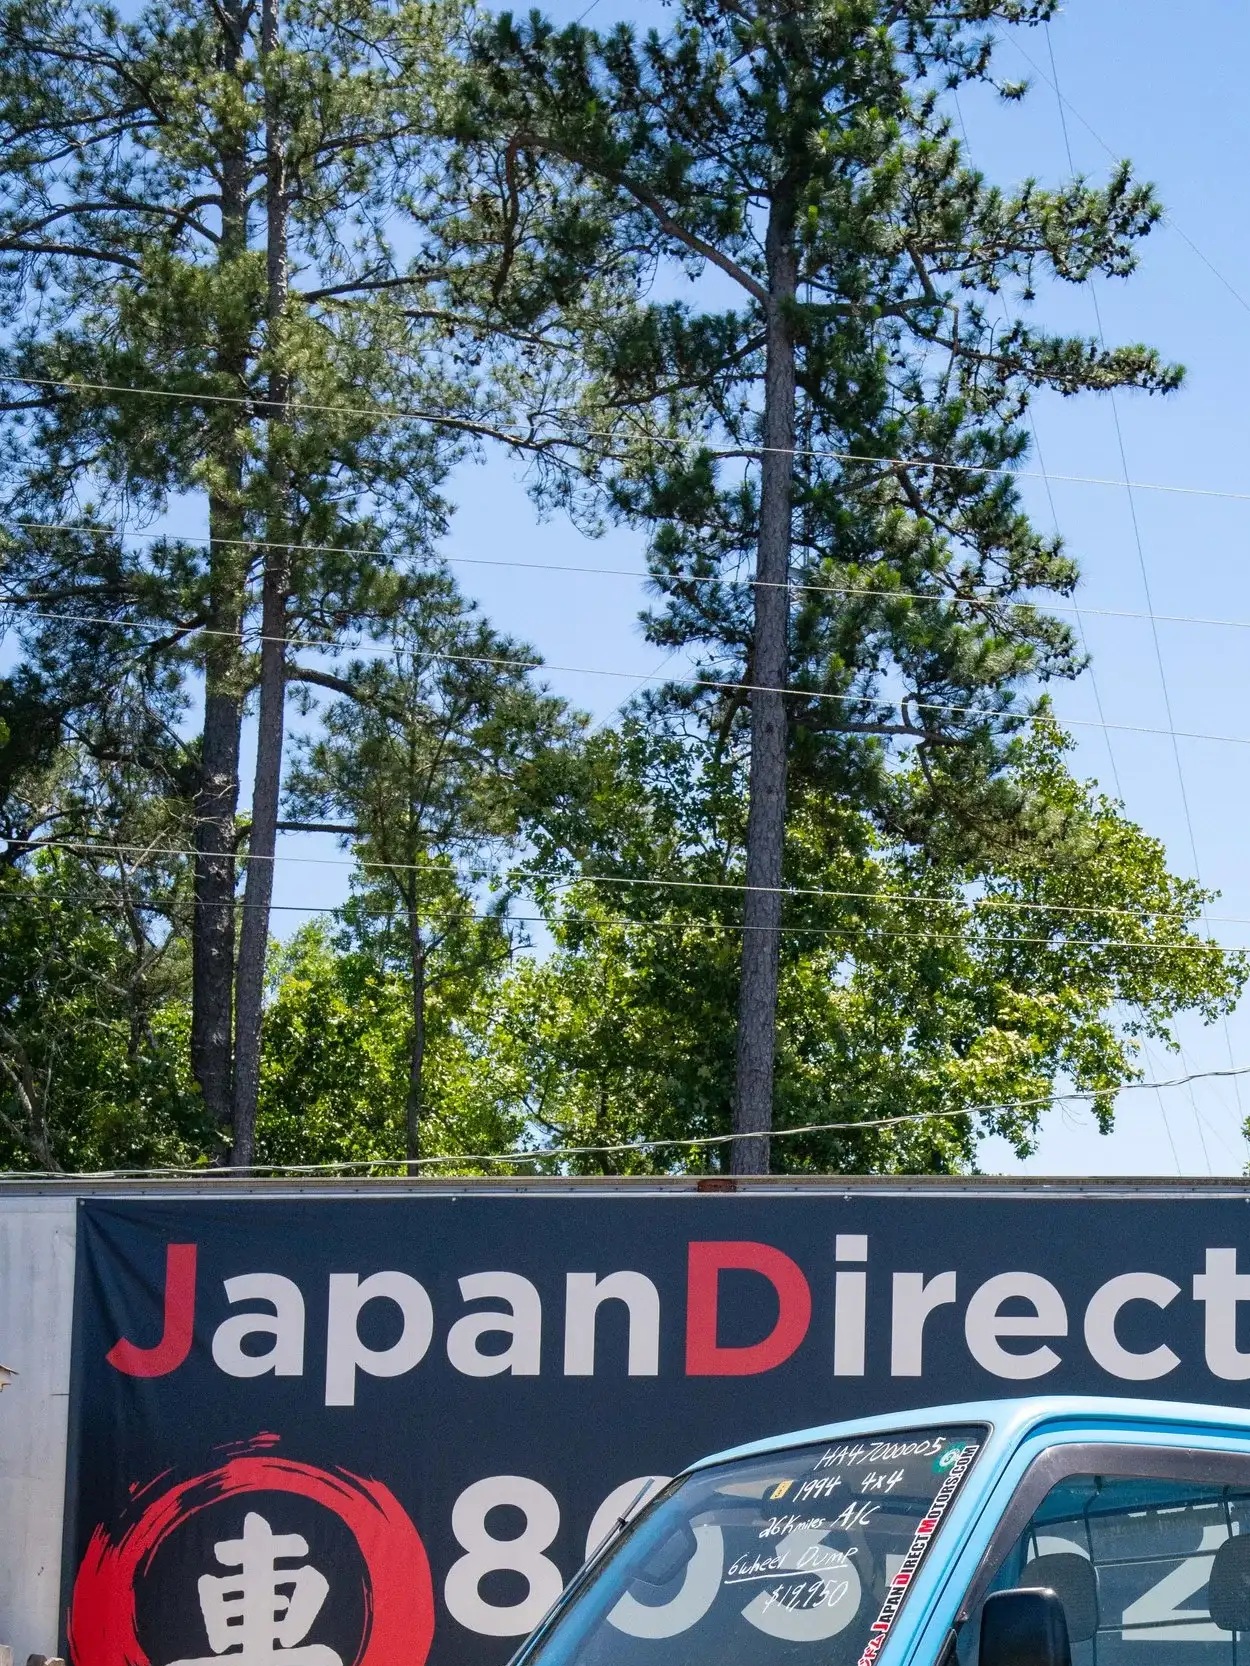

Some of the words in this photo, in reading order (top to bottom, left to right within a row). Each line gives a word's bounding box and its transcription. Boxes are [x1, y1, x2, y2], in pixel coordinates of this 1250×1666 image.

[793, 1476, 841, 1502] 1994
[830, 1501, 880, 1531] A/C
[871, 1445, 980, 1633] JAPANDIRECTMOTORS.COM
[762, 1579, 849, 1614] $19,950
